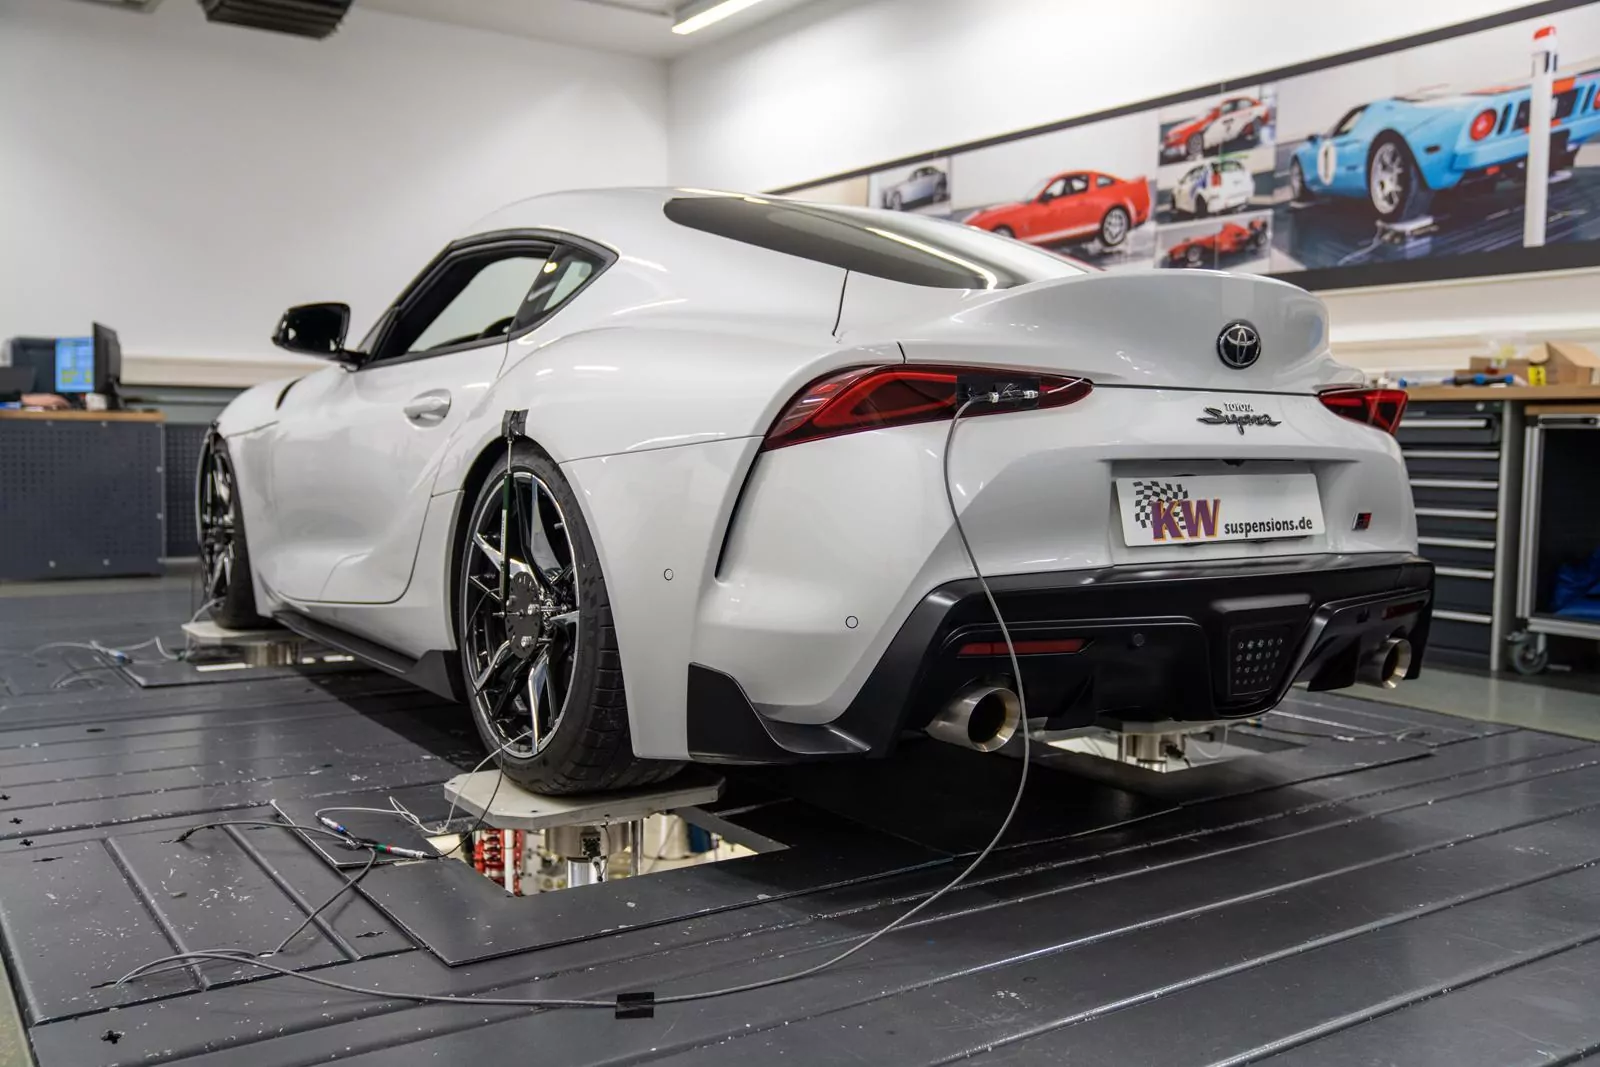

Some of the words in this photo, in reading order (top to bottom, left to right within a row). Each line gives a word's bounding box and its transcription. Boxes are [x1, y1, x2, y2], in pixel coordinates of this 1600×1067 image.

[1224, 402, 1254, 412] TOYOTA
[1196, 407, 1282, 435] Supra
[1151, 498, 1220, 541] KW
[1224, 516, 1313, 537] suspensions.de
